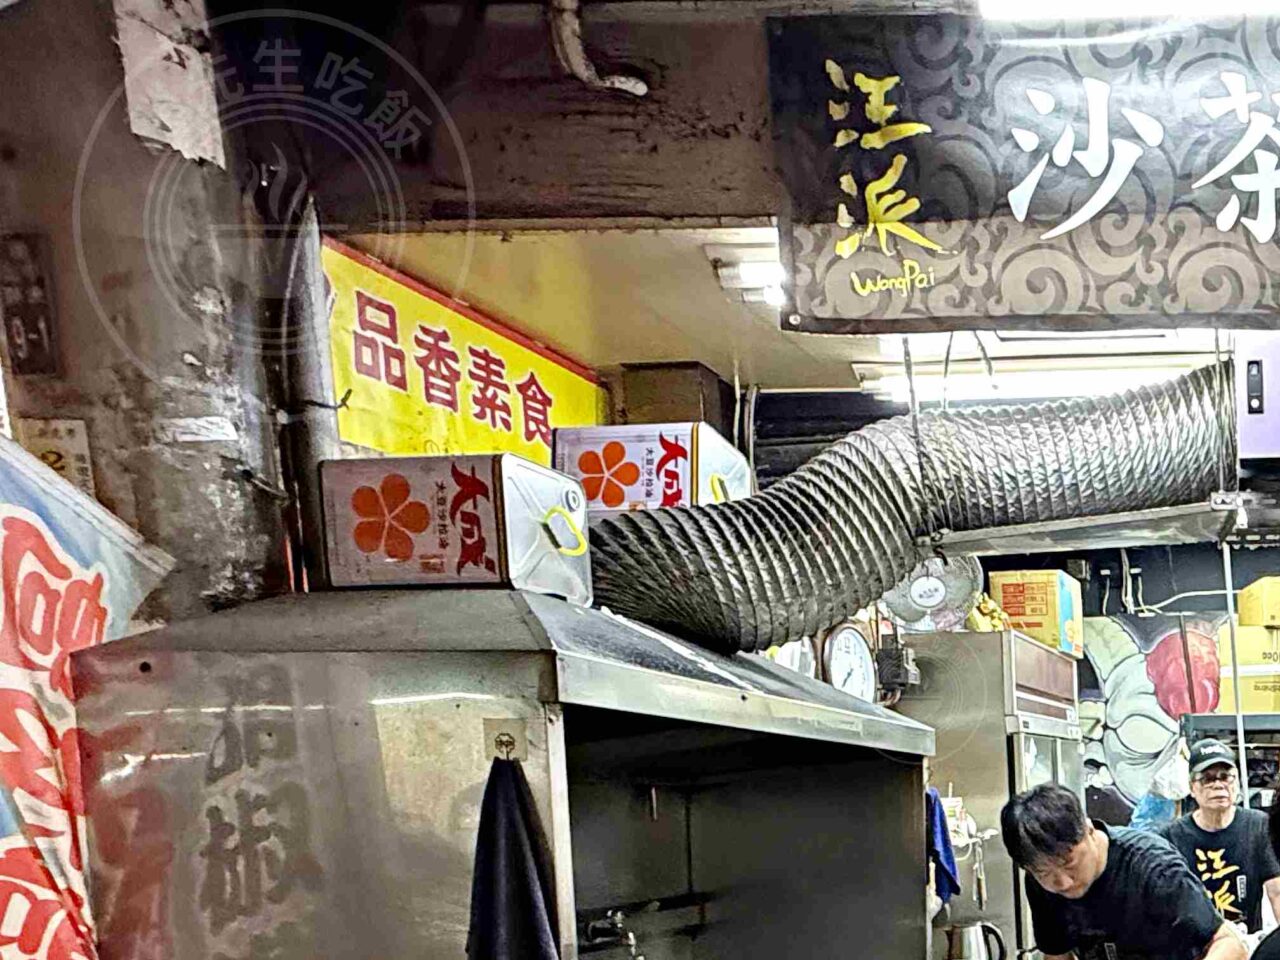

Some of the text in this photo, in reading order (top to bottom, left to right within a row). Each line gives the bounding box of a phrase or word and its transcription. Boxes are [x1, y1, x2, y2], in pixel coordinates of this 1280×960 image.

[851, 260, 935, 296] WongPai
[353, 290, 552, 447] 品香素食
